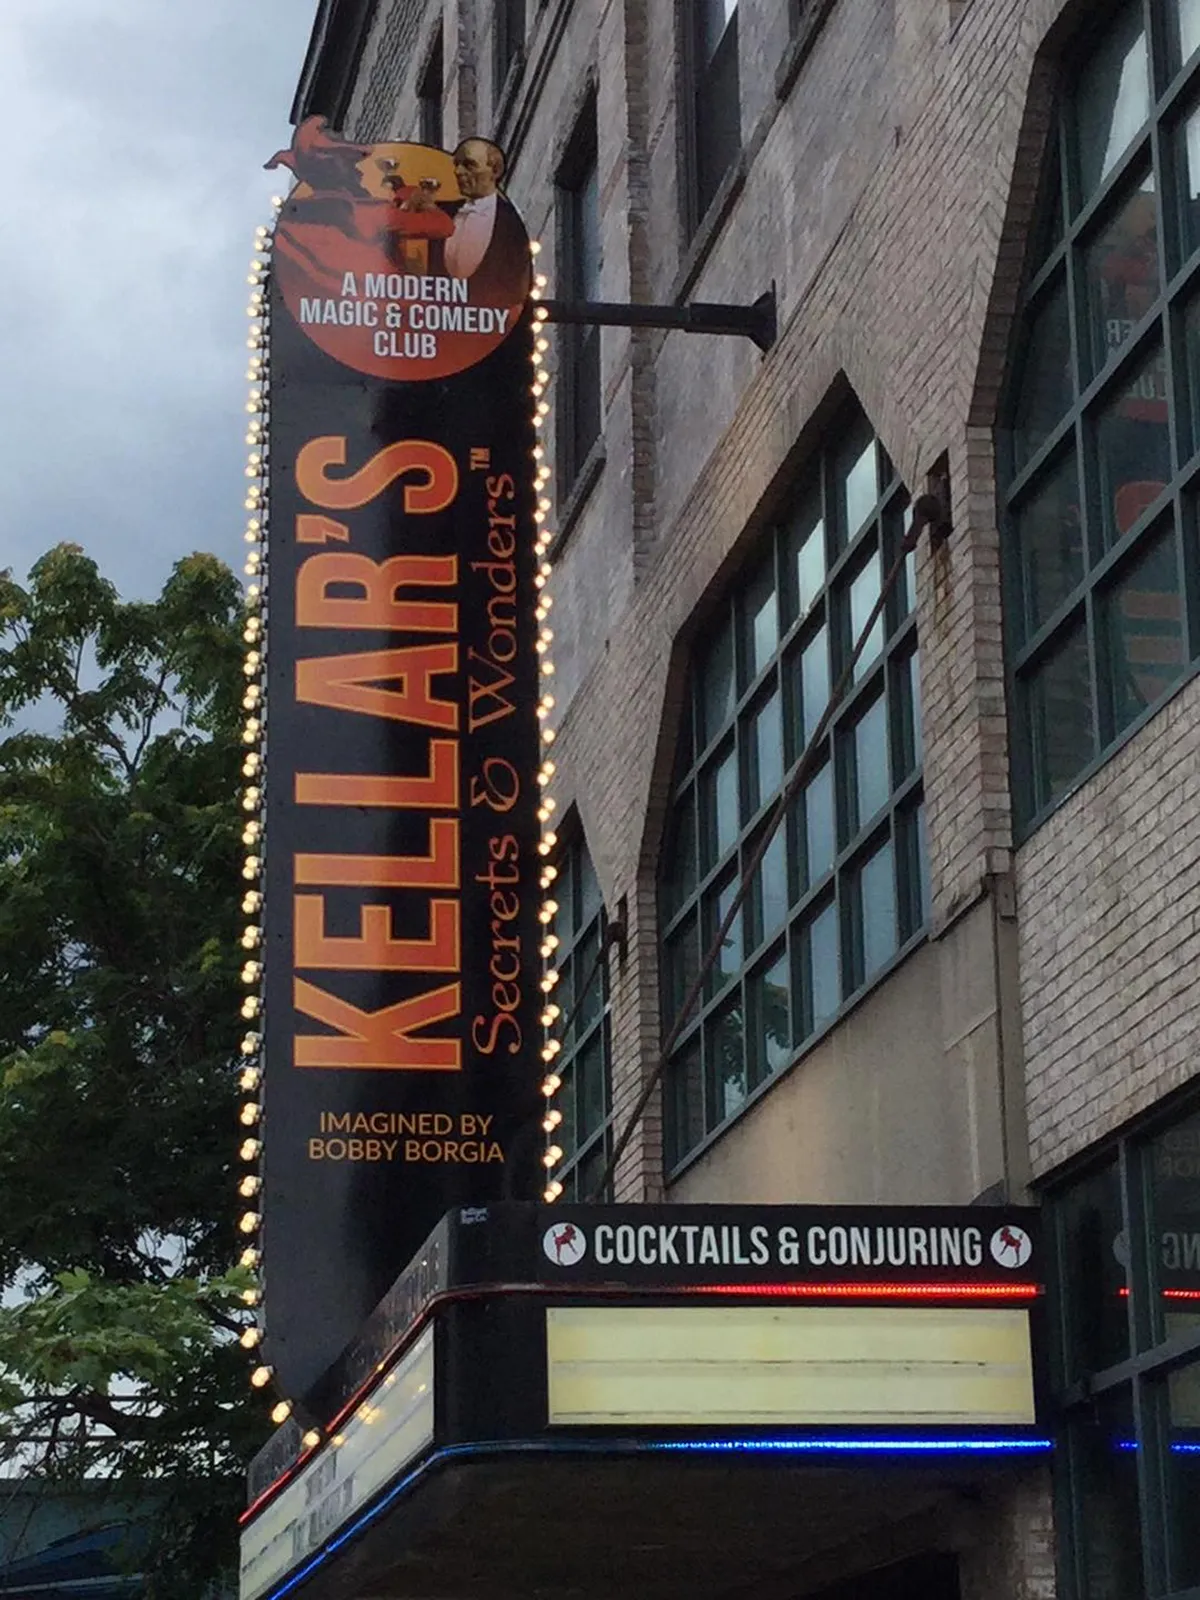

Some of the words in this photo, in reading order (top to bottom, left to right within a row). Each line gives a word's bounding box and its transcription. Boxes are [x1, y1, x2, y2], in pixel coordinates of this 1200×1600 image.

[341, 272, 357, 297] A
[365, 273, 468, 303] MODERN
[300, 298, 378, 327] MAGIC
[385, 303, 402, 328] &
[409, 304, 509, 334] COMEDY
[374, 330, 437, 359] CLUB
[468, 472, 517, 735] Wonders
[294, 435, 461, 1070] KELLAR'S
[470, 757, 520, 812] &
[472, 834, 522, 1055] Secrets
[320, 1111, 453, 1135] IMAGINED
[460, 1114, 493, 1136] BY
[309, 1138, 398, 1161] BOBBY
[405, 1141, 505, 1163] BORGIA
[594, 1225, 770, 1265] COCKTAILS
[778, 1226, 800, 1265] &
[807, 1226, 983, 1266] CONJURING
